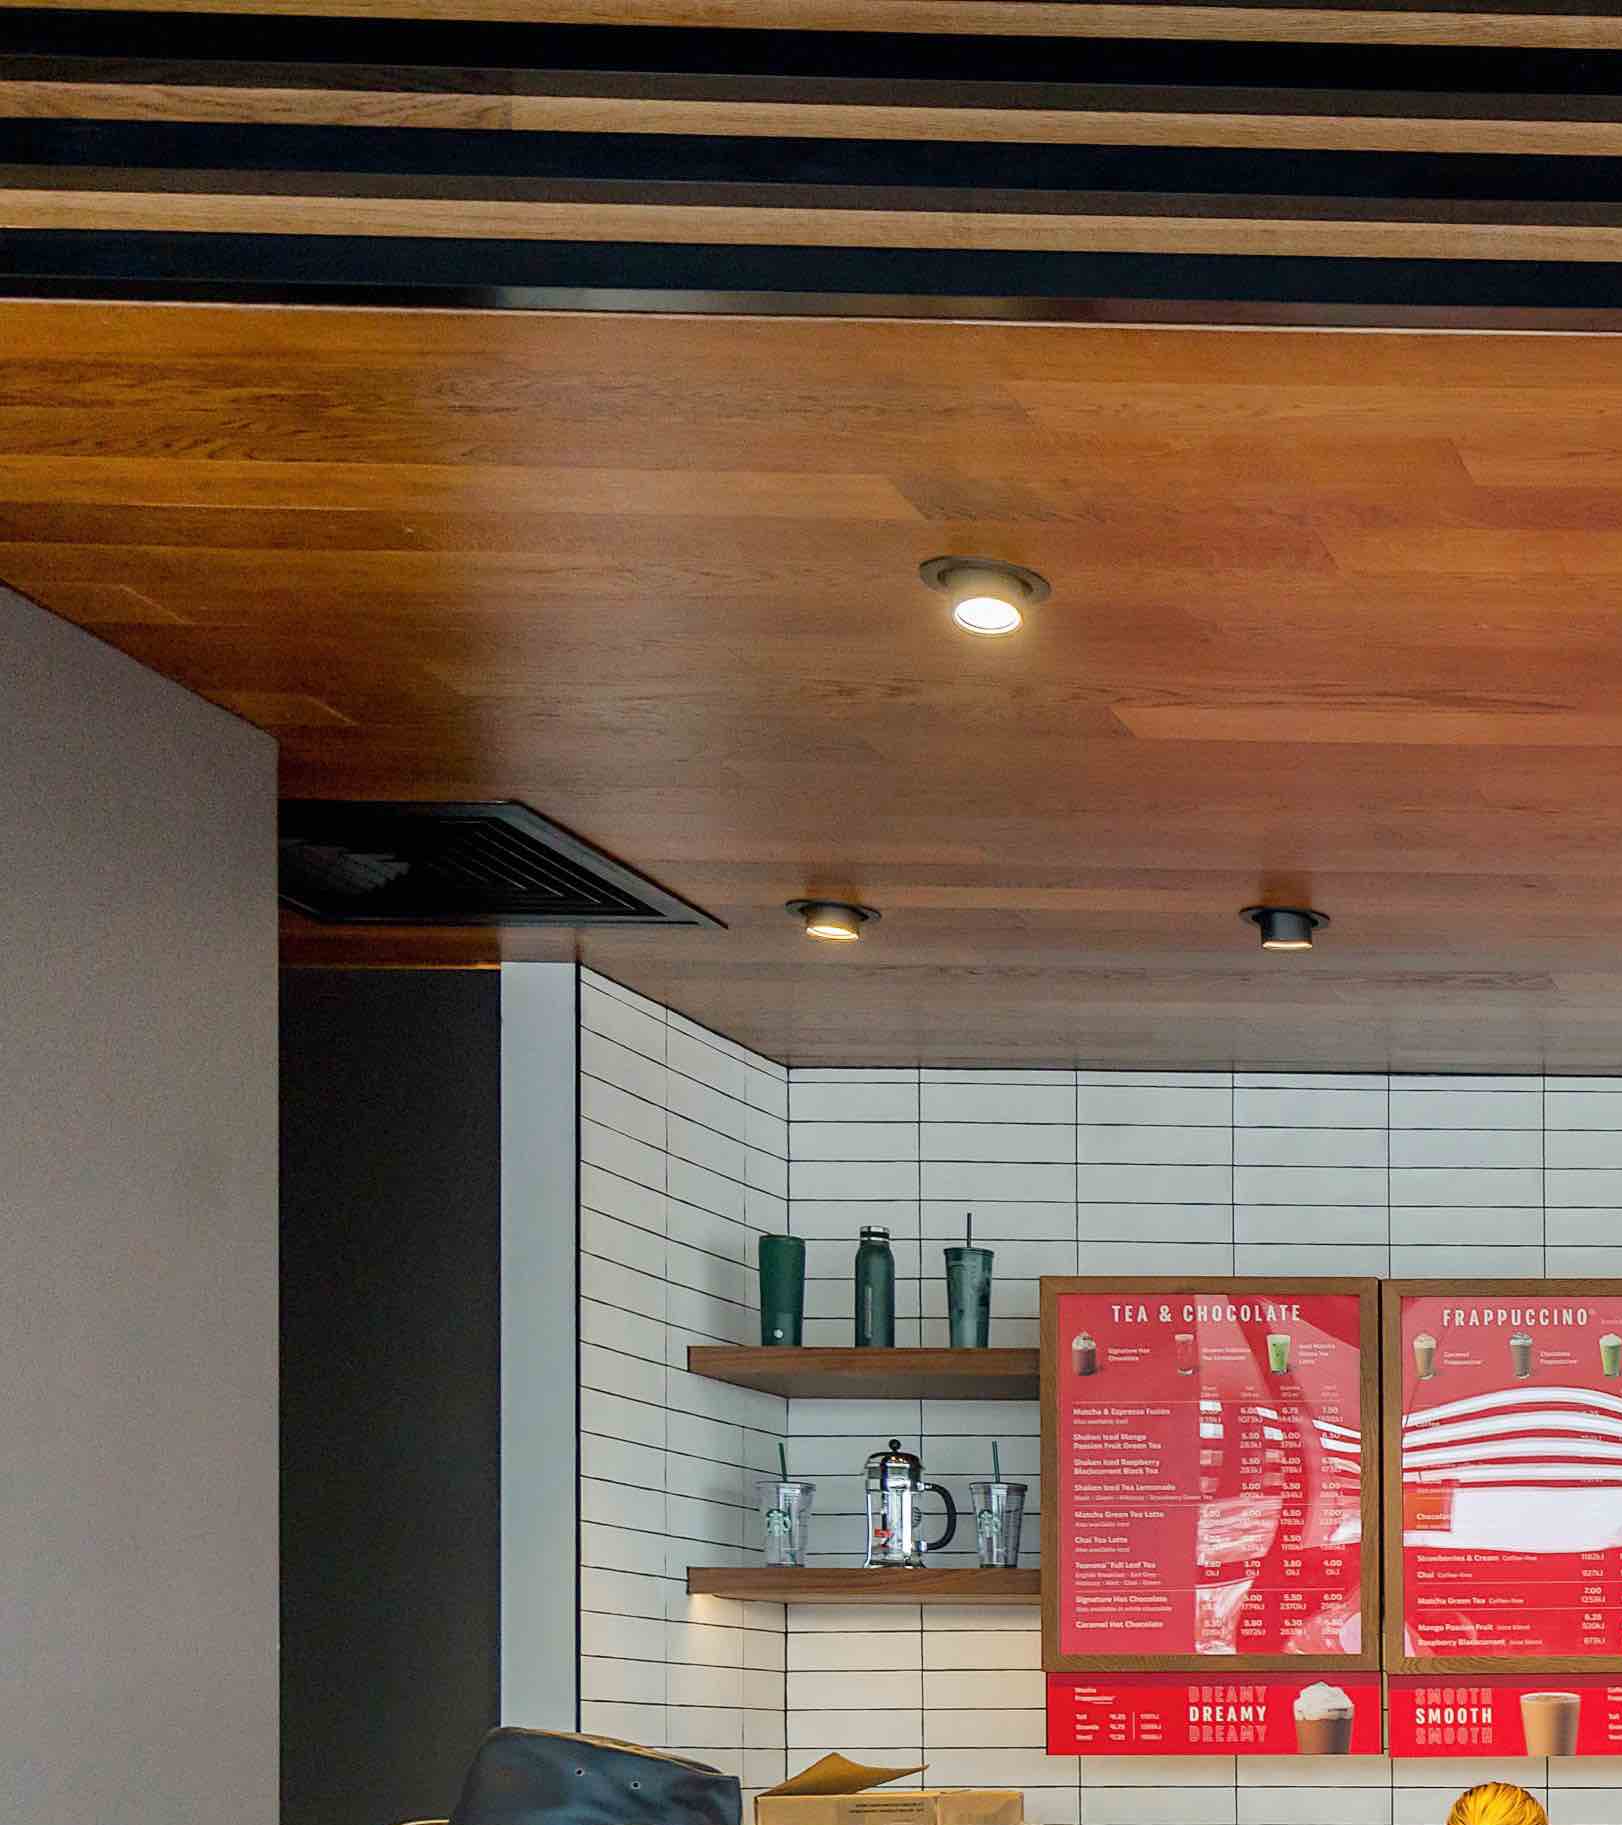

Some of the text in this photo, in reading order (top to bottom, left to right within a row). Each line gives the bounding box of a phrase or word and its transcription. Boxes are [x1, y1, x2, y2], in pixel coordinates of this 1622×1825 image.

[1112, 1304, 1301, 1323] TEA & CHOCOLATE
[1188, 1686, 1267, 1703] DREAMY
[1415, 1687, 1493, 1705] SMOOTH
[1188, 1706, 1267, 1722] DREAMY
[1415, 1707, 1493, 1724] SMOOTH
[1188, 1725, 1267, 1742] DREAMY
[1415, 1727, 1493, 1745] SMOOTH
